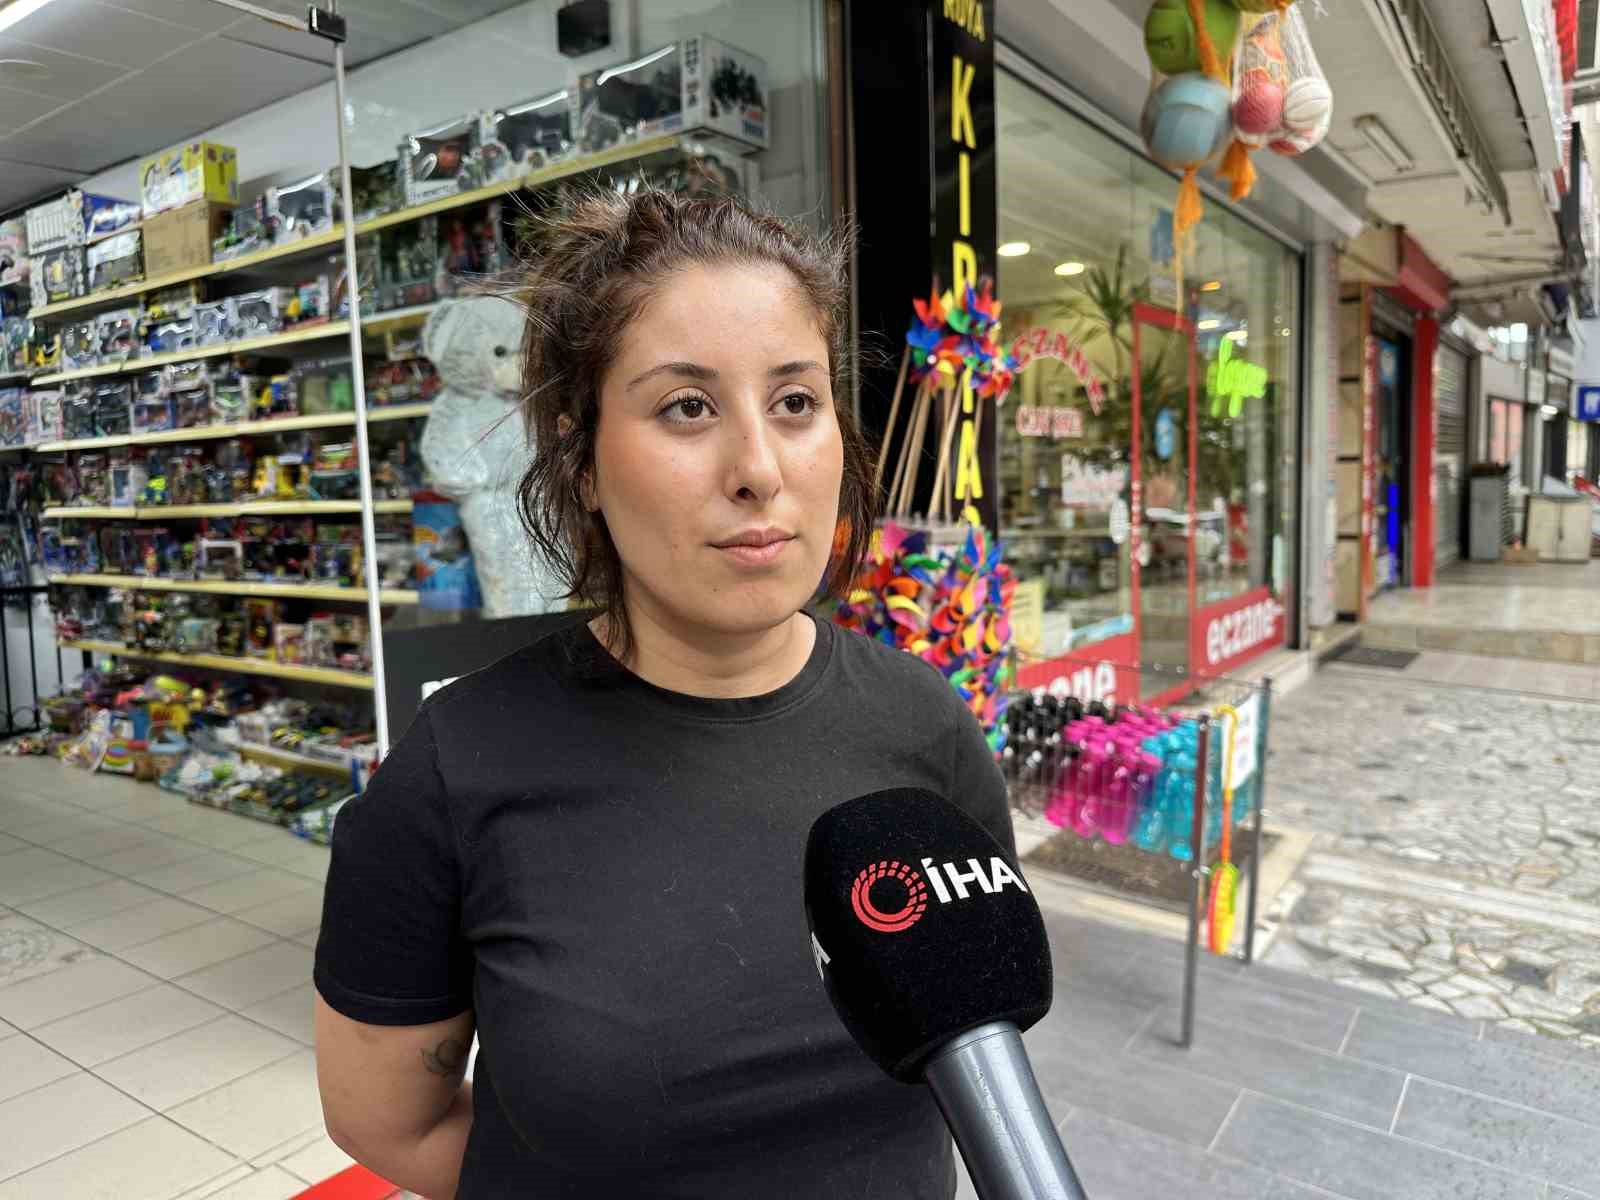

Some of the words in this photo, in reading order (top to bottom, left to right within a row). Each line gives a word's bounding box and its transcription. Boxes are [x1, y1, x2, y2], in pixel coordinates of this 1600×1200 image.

[1008, 326, 1106, 416] CZANE
[1207, 598, 1279, 665] eczane
[921, 857, 1028, 904] İHA
